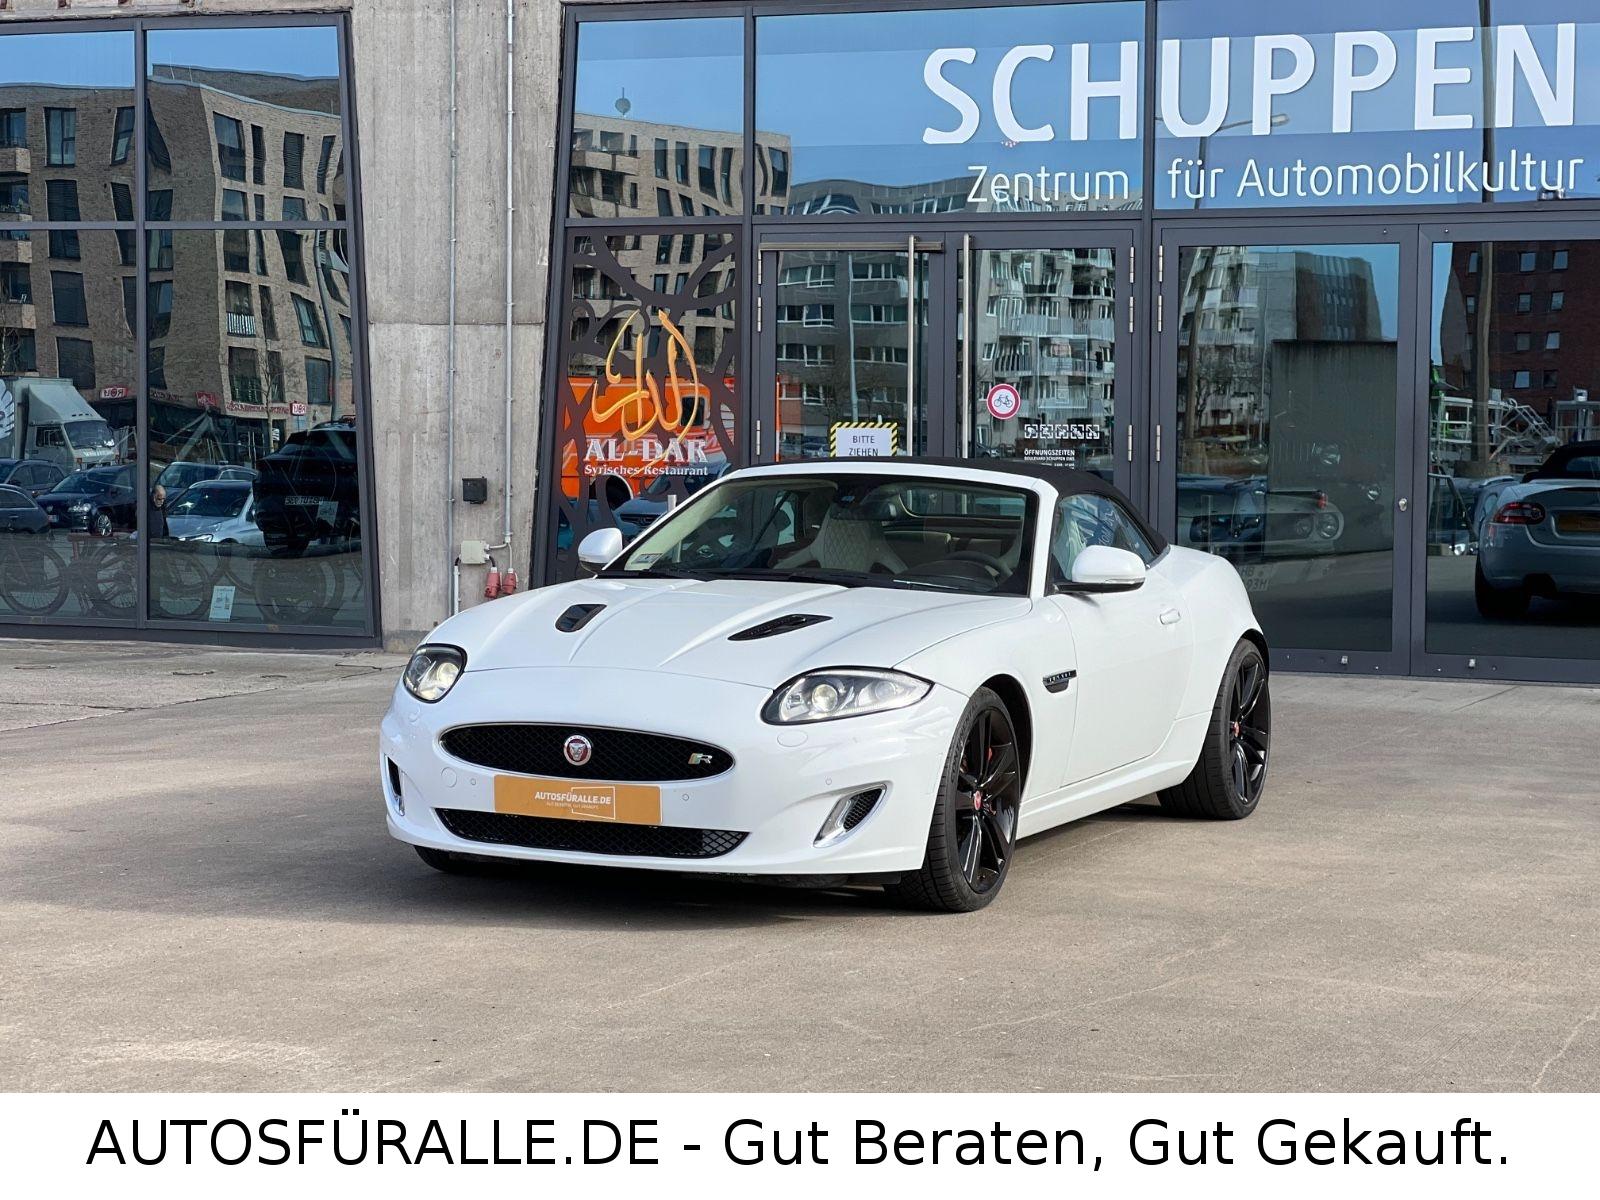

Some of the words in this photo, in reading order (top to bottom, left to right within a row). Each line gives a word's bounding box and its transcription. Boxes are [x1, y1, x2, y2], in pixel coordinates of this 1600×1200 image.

[922, 22, 1576, 146] SCHUPPEN
[966, 165, 1130, 204] Zentrum
[1167, 157, 1224, 200] für
[1235, 150, 1584, 198] Automobilkultur
[852, 435, 876, 444] BITTE
[583, 438, 709, 463] AL-DAR
[848, 447, 879, 457] ZIEHEN
[1023, 447, 1076, 456] ÖFFNUNGSZEITEN
[584, 464, 640, 477] Syrisches
[643, 465, 709, 477] Restaurant
[534, 791, 612, 805] AUTOSFÜRALLE.DE
